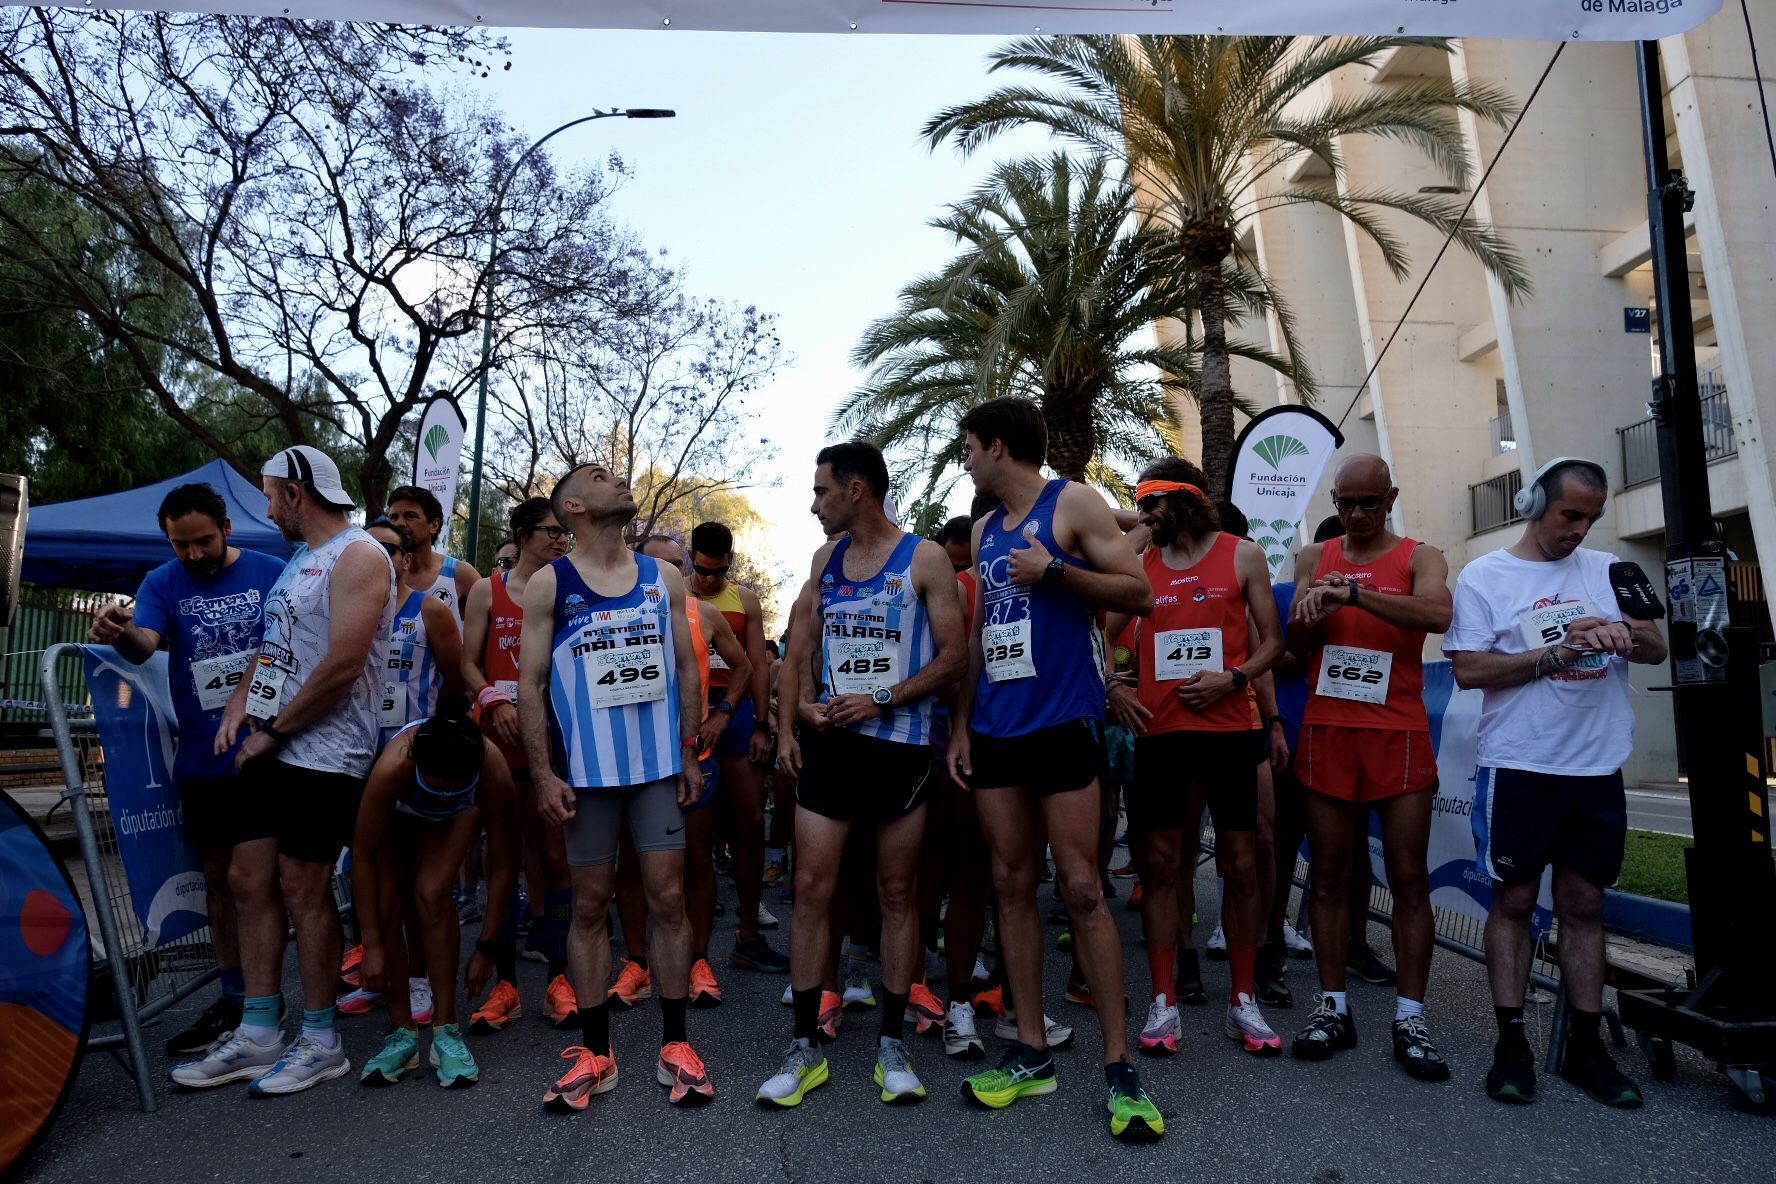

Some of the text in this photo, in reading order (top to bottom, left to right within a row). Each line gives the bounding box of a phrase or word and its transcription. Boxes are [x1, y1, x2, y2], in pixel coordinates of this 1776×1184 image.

[1627, 308, 1647, 318] V27
[424, 466, 450, 478] Fundación
[1250, 472, 1307, 483] Fundación
[428, 481, 447, 493] Unicaja
[1256, 487, 1296, 498] Unicaja
[193, 594, 248, 612] Carrera
[1154, 594, 1178, 605] alifas
[825, 612, 885, 623] ATLETISMO
[583, 623, 656, 638] ATLETISMO
[986, 642, 1025, 663] 235
[1166, 646, 1212, 661] 413
[837, 657, 891, 675] 485
[205, 671, 245, 690] 48
[596, 665, 660, 686] 496
[1327, 664, 1384, 685] 662
[382, 699, 395, 711] 3
[1431, 791, 1473, 817] diputaci
[120, 803, 176, 841] diputación
